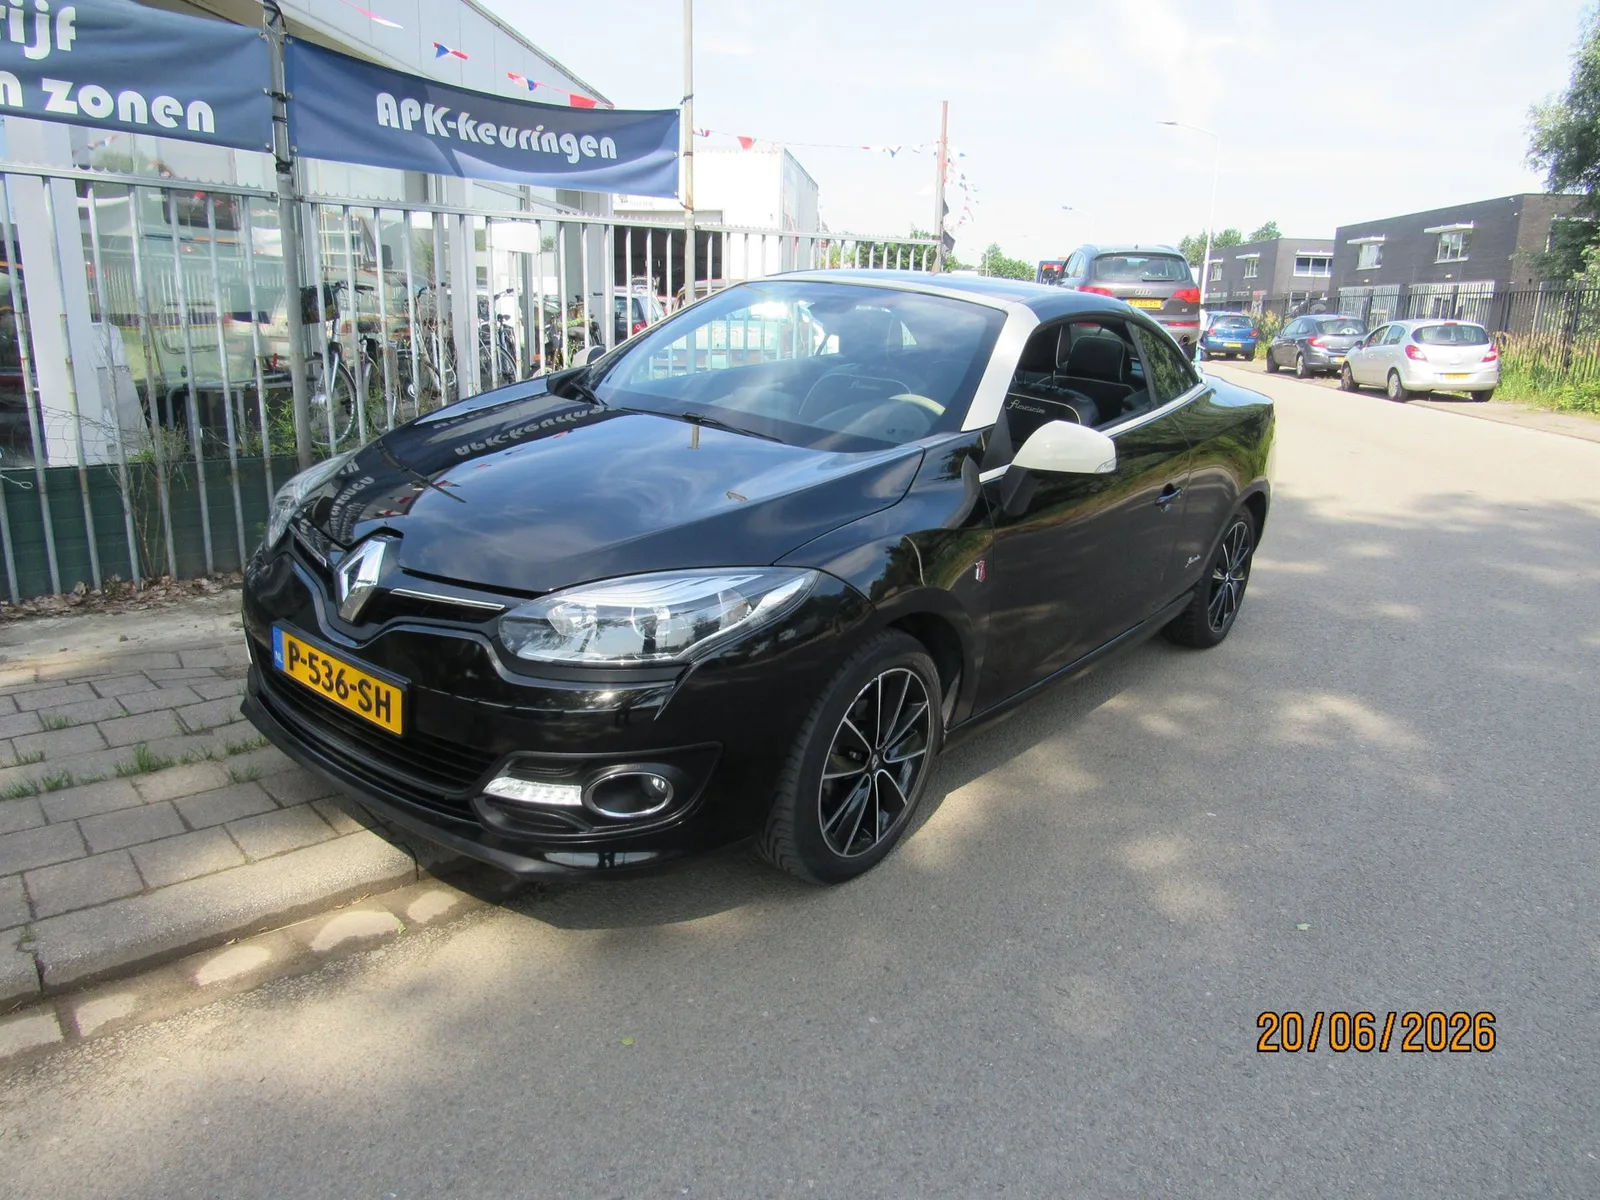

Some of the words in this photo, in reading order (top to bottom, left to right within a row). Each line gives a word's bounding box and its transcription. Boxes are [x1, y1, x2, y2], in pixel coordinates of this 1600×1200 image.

[0, 0, 77, 60] ijf
[42, 77, 215, 134] zonen
[376, 92, 617, 164] APK-keuringen
[288, 640, 391, 724] P-536-SH
